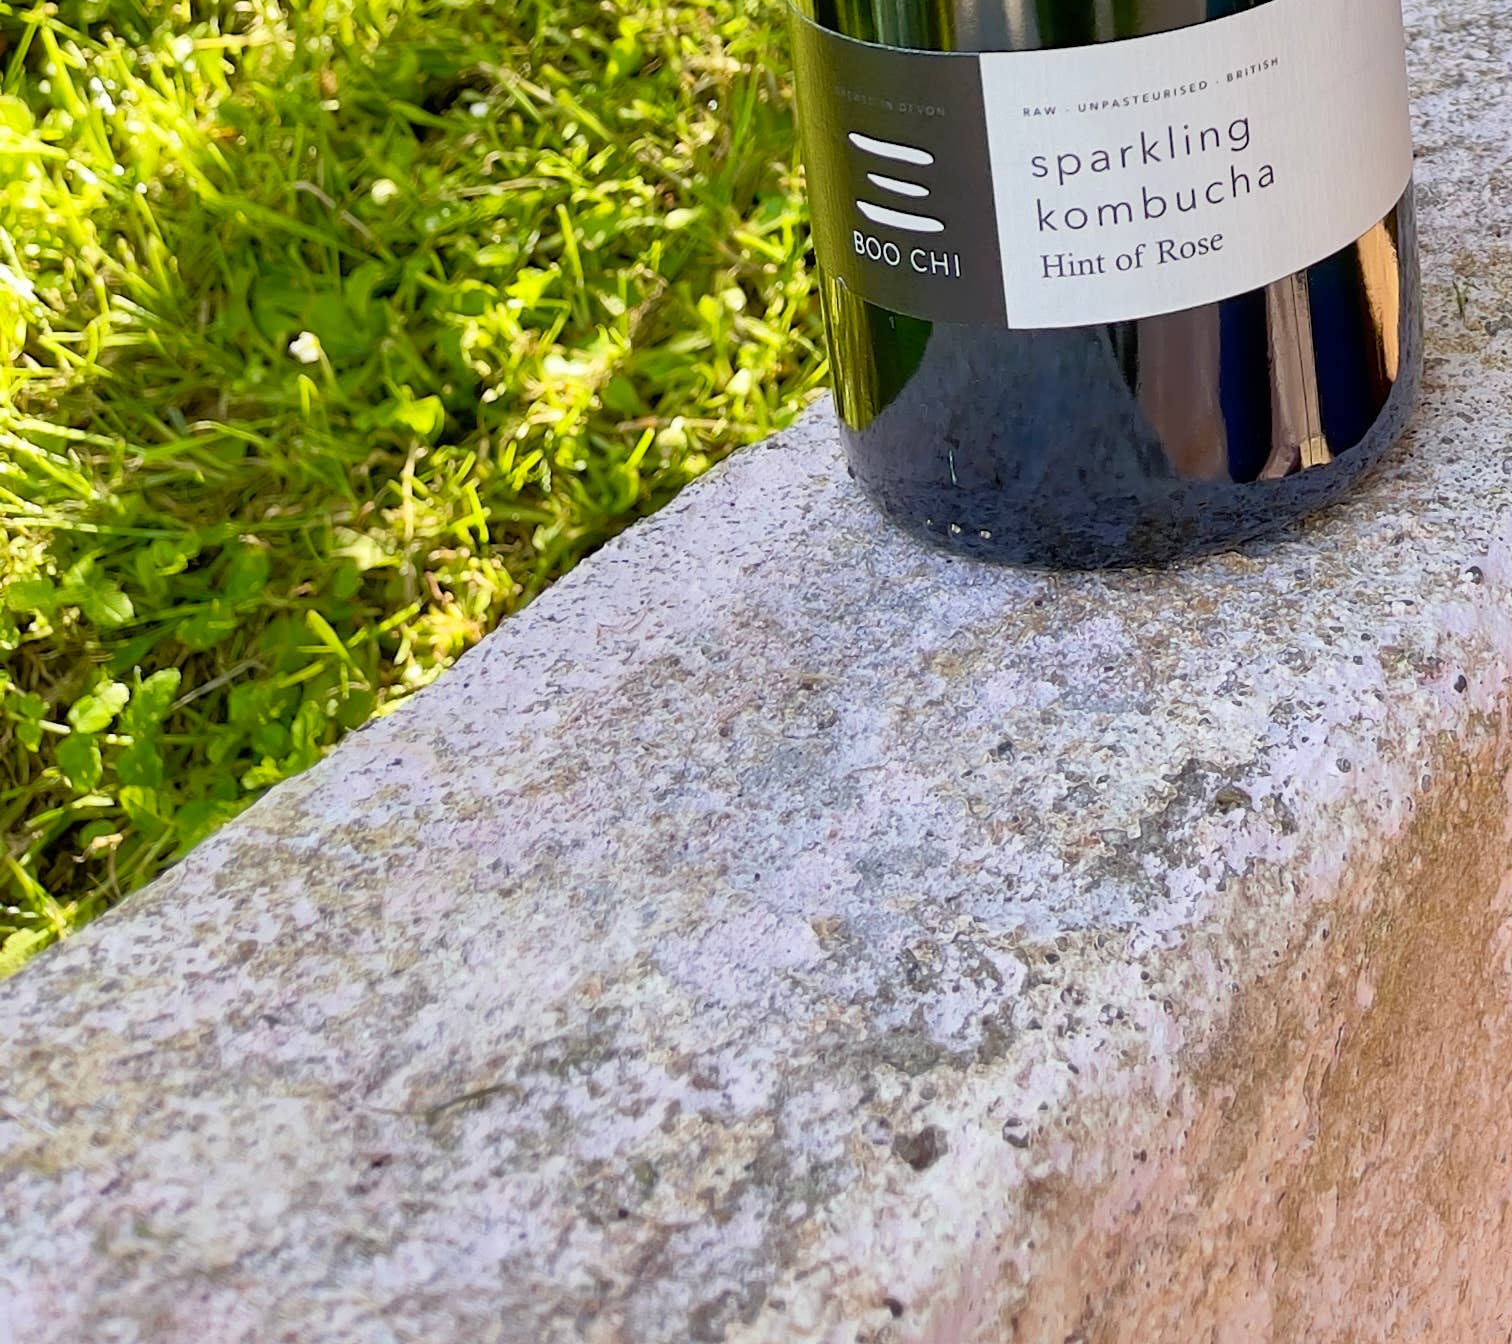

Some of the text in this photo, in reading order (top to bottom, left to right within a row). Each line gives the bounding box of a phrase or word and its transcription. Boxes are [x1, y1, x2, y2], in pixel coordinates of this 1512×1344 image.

[1023, 57, 1279, 117] RAW UNPASTEURISED BRITISH
[1031, 116, 1250, 187] sparkling
[1036, 164, 1275, 232] kombucha
[852, 230, 962, 278] BOO CHI
[1039, 233, 1225, 279] Hint of Rose
